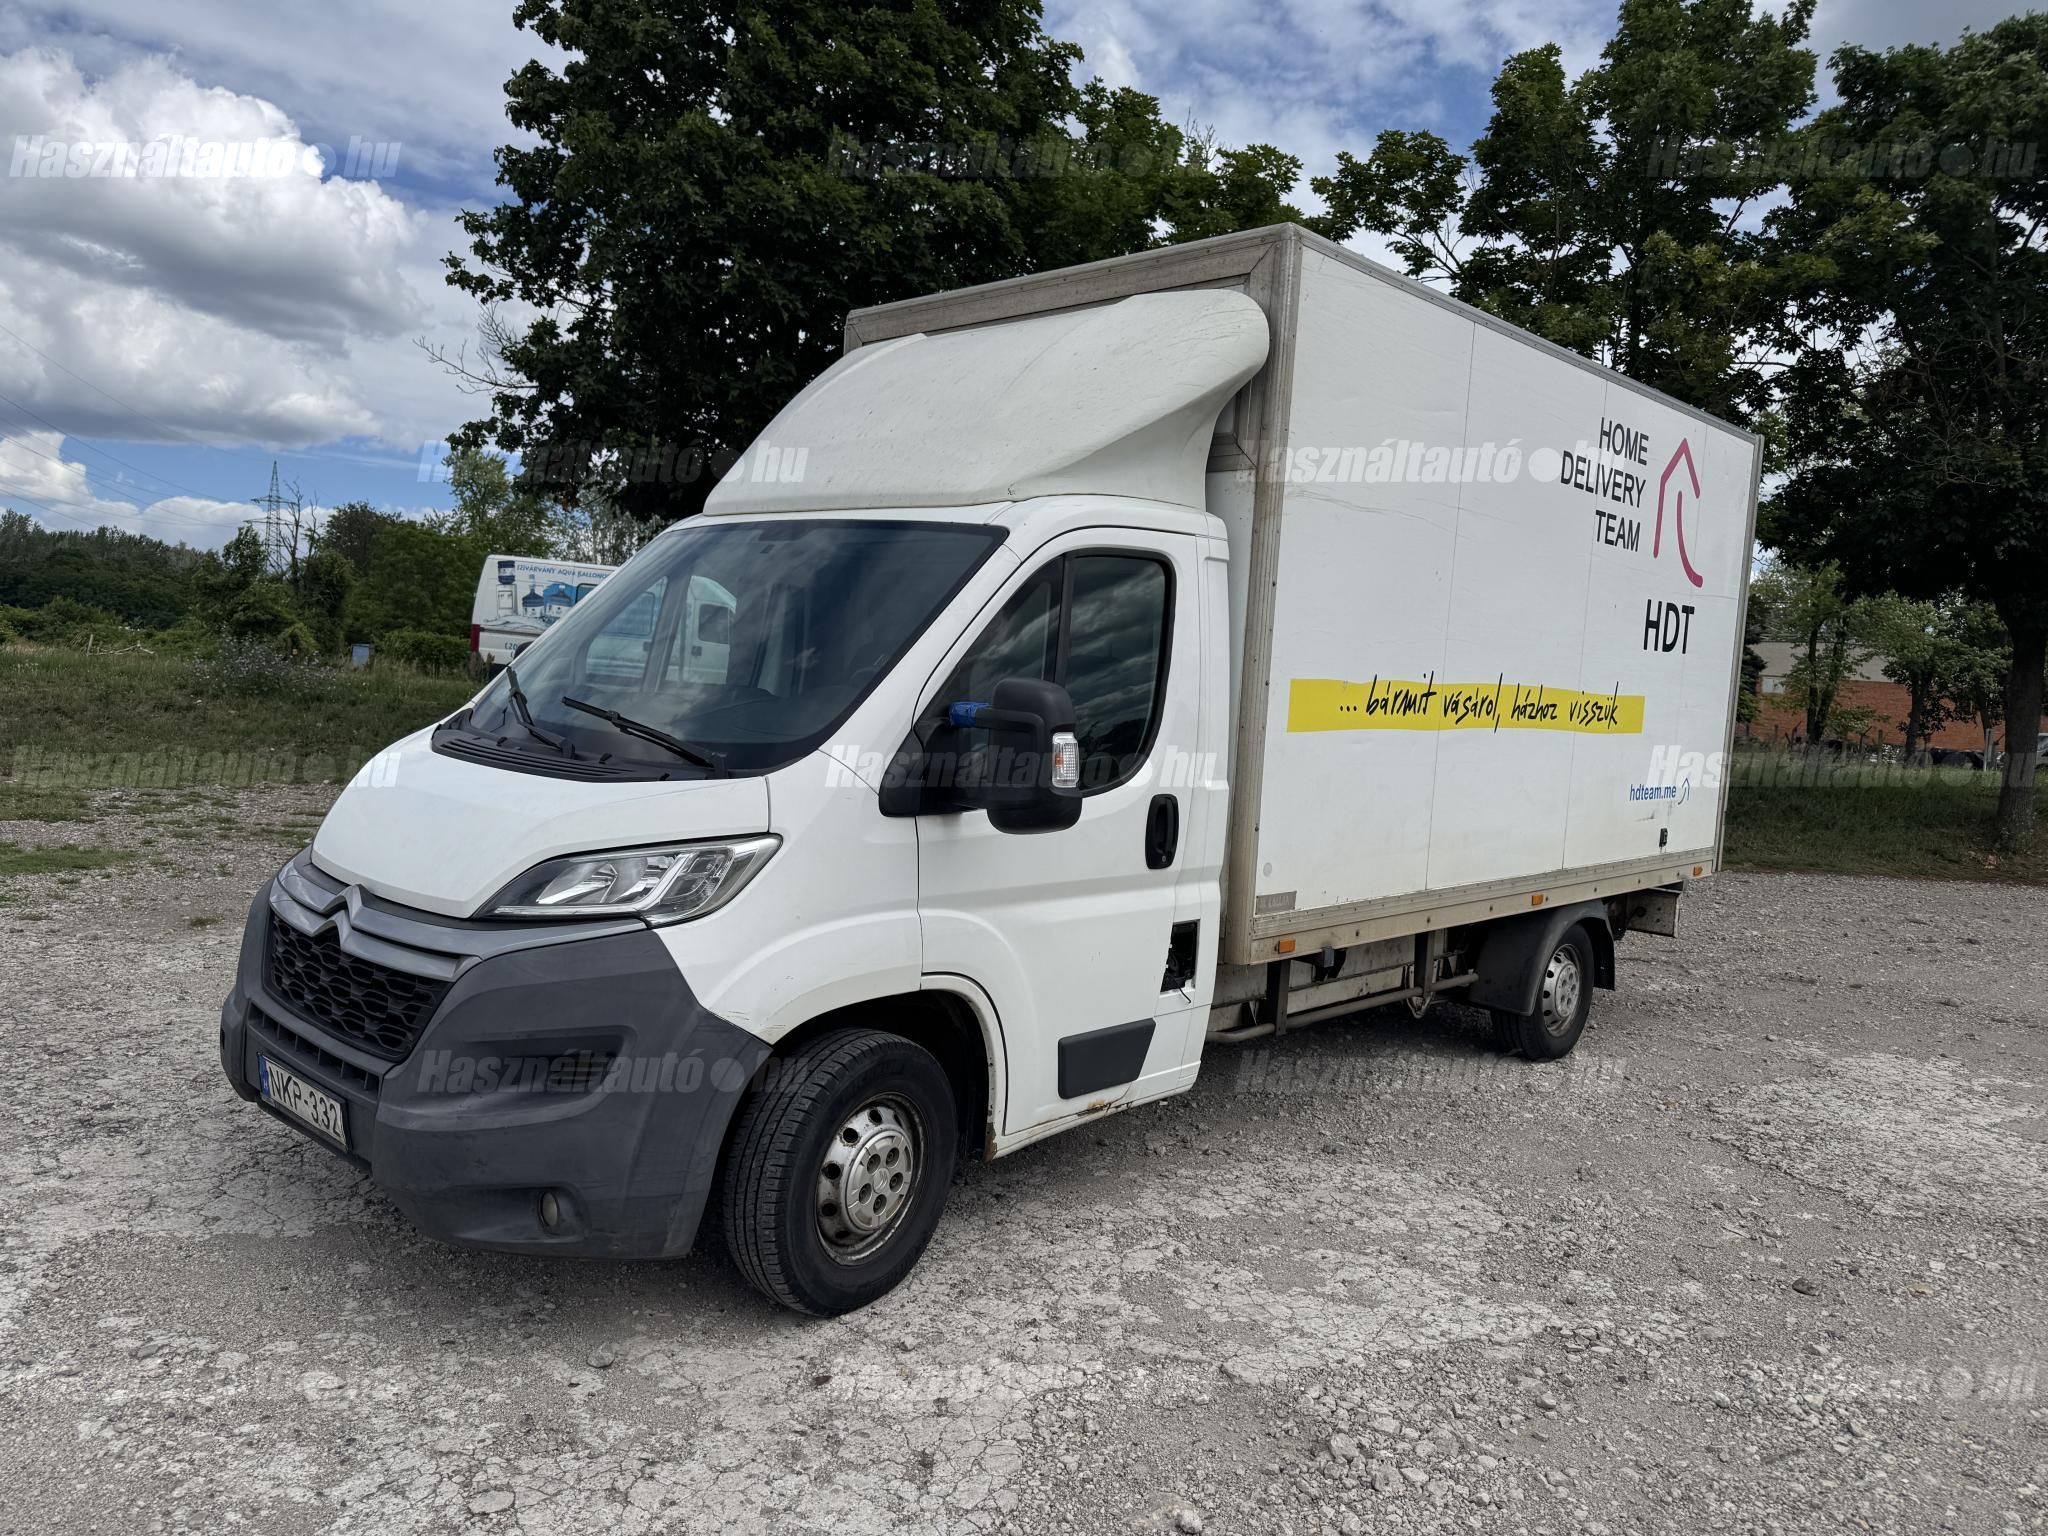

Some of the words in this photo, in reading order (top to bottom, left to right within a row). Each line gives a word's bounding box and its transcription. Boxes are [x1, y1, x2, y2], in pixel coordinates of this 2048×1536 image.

[1599, 416, 1649, 466] HOME
[1560, 450, 1646, 508] DELIVERY
[1595, 509, 1641, 552] TEAM
[557, 568, 576, 577] AQUA
[1643, 599, 1695, 655] HDT
[1511, 683, 1558, 721] házhoz
[1569, 681, 1619, 729] visszük
[1629, 783, 1677, 801] hdteam.me
[268, 1066, 342, 1138] NKP-332
